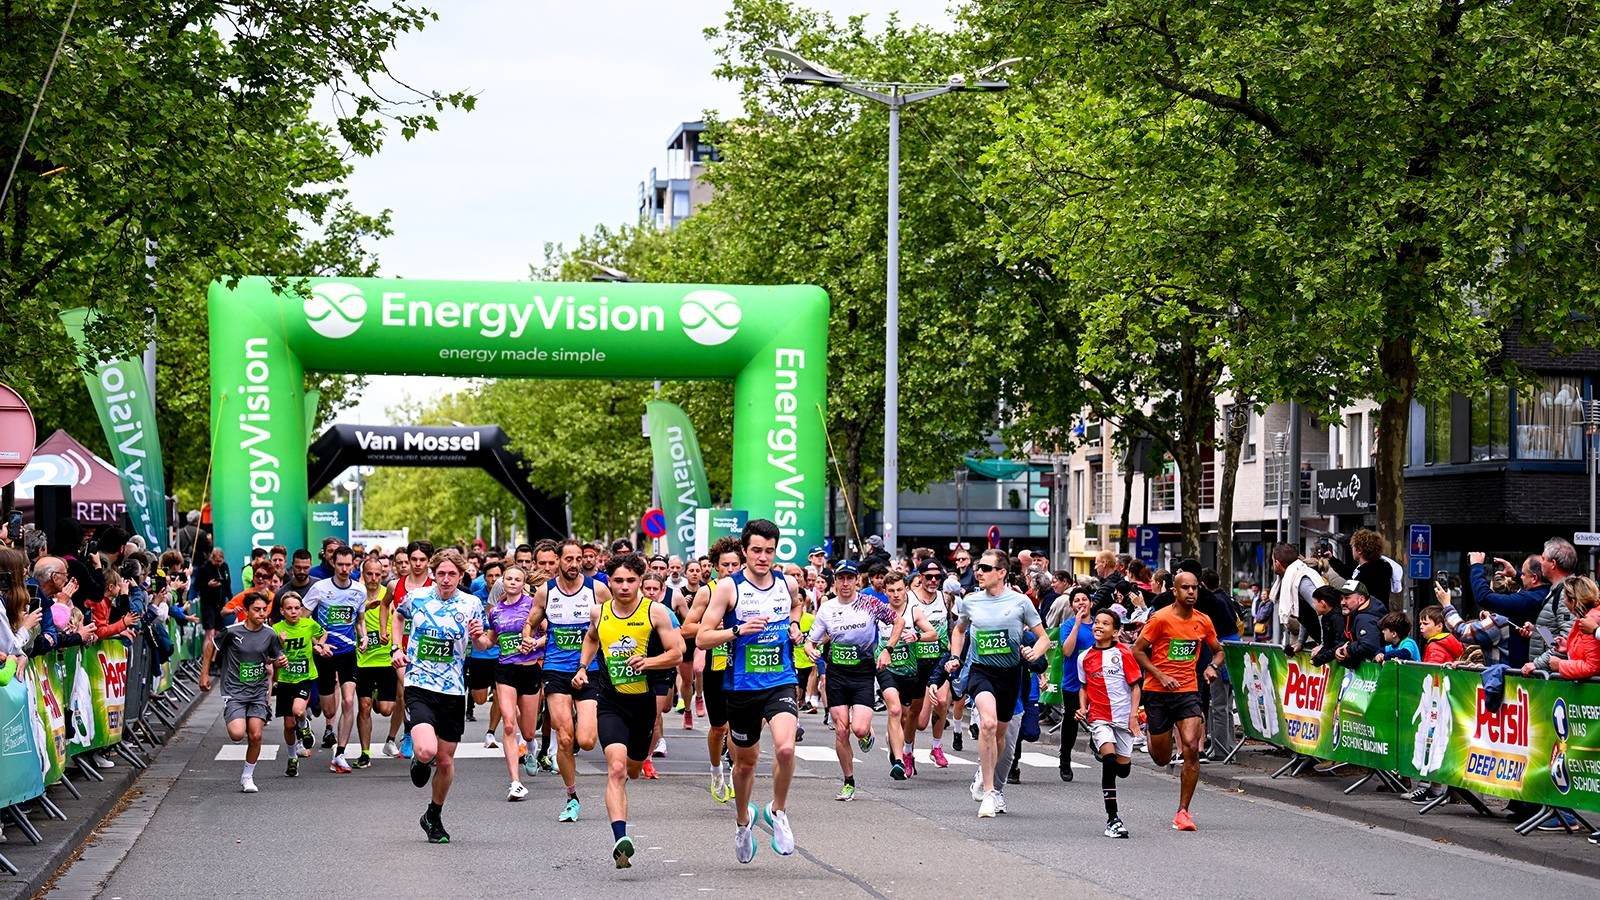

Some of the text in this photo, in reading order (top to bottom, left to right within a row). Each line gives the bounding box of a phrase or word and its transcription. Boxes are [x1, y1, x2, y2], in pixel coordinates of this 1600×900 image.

[382, 292, 665, 338] EnergyVision
[439, 347, 606, 363] energy made simple
[355, 431, 481, 451] Van Mossel
[238, 338, 280, 566] nergyVision
[766, 348, 805, 566] EnergyVisio
[1141, 529, 1153, 546] P
[330, 611, 351, 620] 3563
[502, 638, 523, 650] 335
[557, 635, 583, 645] 3774
[979, 638, 1007, 649] 3428
[421, 644, 450, 657] 3742
[834, 650, 858, 660] 3523
[891, 651, 908, 661] 360
[918, 644, 940, 654] 3503
[1171, 646, 1195, 656] 3387
[750, 654, 779, 666] 3813
[1284, 662, 1330, 712] Persil
[1473, 686, 1529, 747] Persil
[1570, 722, 1587, 737] WAS
[1467, 753, 1526, 782] DEEP CLEAN
[1568, 758, 1585, 773] EEN
